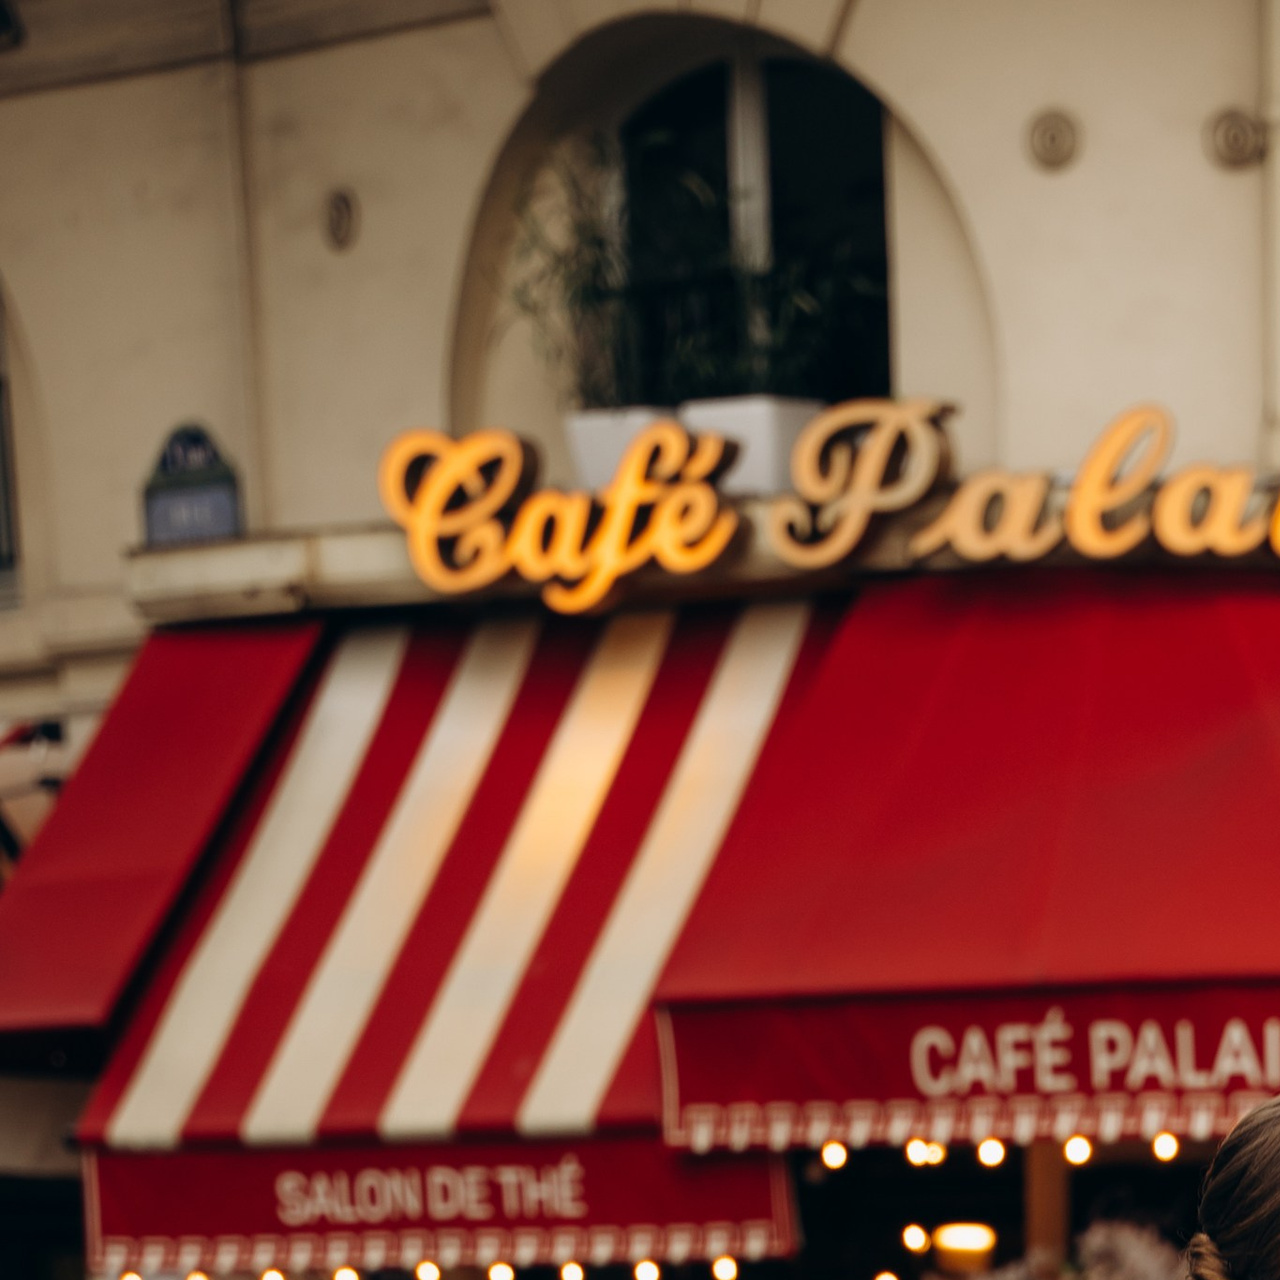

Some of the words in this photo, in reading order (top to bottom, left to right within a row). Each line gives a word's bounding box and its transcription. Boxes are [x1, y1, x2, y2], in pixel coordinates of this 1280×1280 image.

[379, 421, 738, 613] Café
[911, 1007, 1076, 1096] CAFÉ
[276, 1172, 421, 1225] SALON
[425, 1167, 493, 1220] DE
[496, 1156, 586, 1217] THÉ
